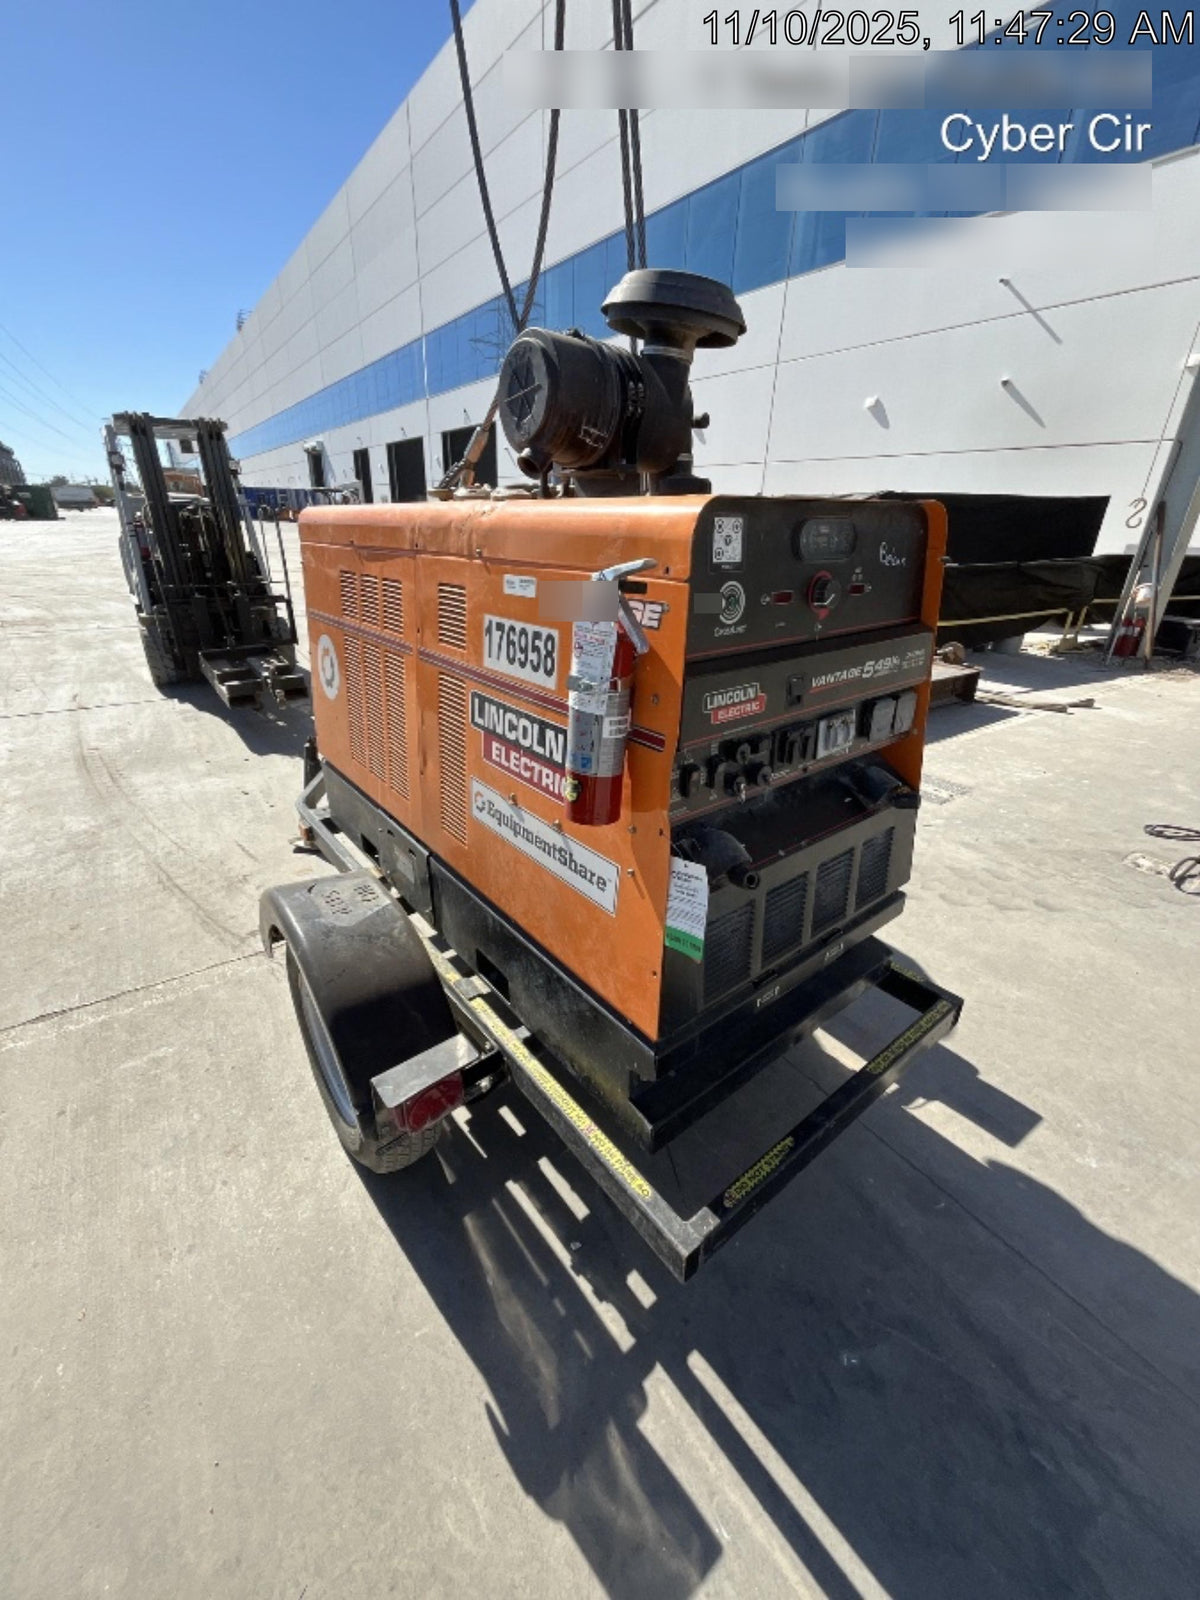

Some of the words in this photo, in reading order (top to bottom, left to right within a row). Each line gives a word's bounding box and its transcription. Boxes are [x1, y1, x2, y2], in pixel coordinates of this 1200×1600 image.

[485, 619, 556, 678] 176958
[706, 685, 757, 710] LINCOLN
[717, 701, 761, 720] ELECTRIC
[473, 696, 565, 764] LINCOLN
[486, 799, 608, 893] EquipmentShare
